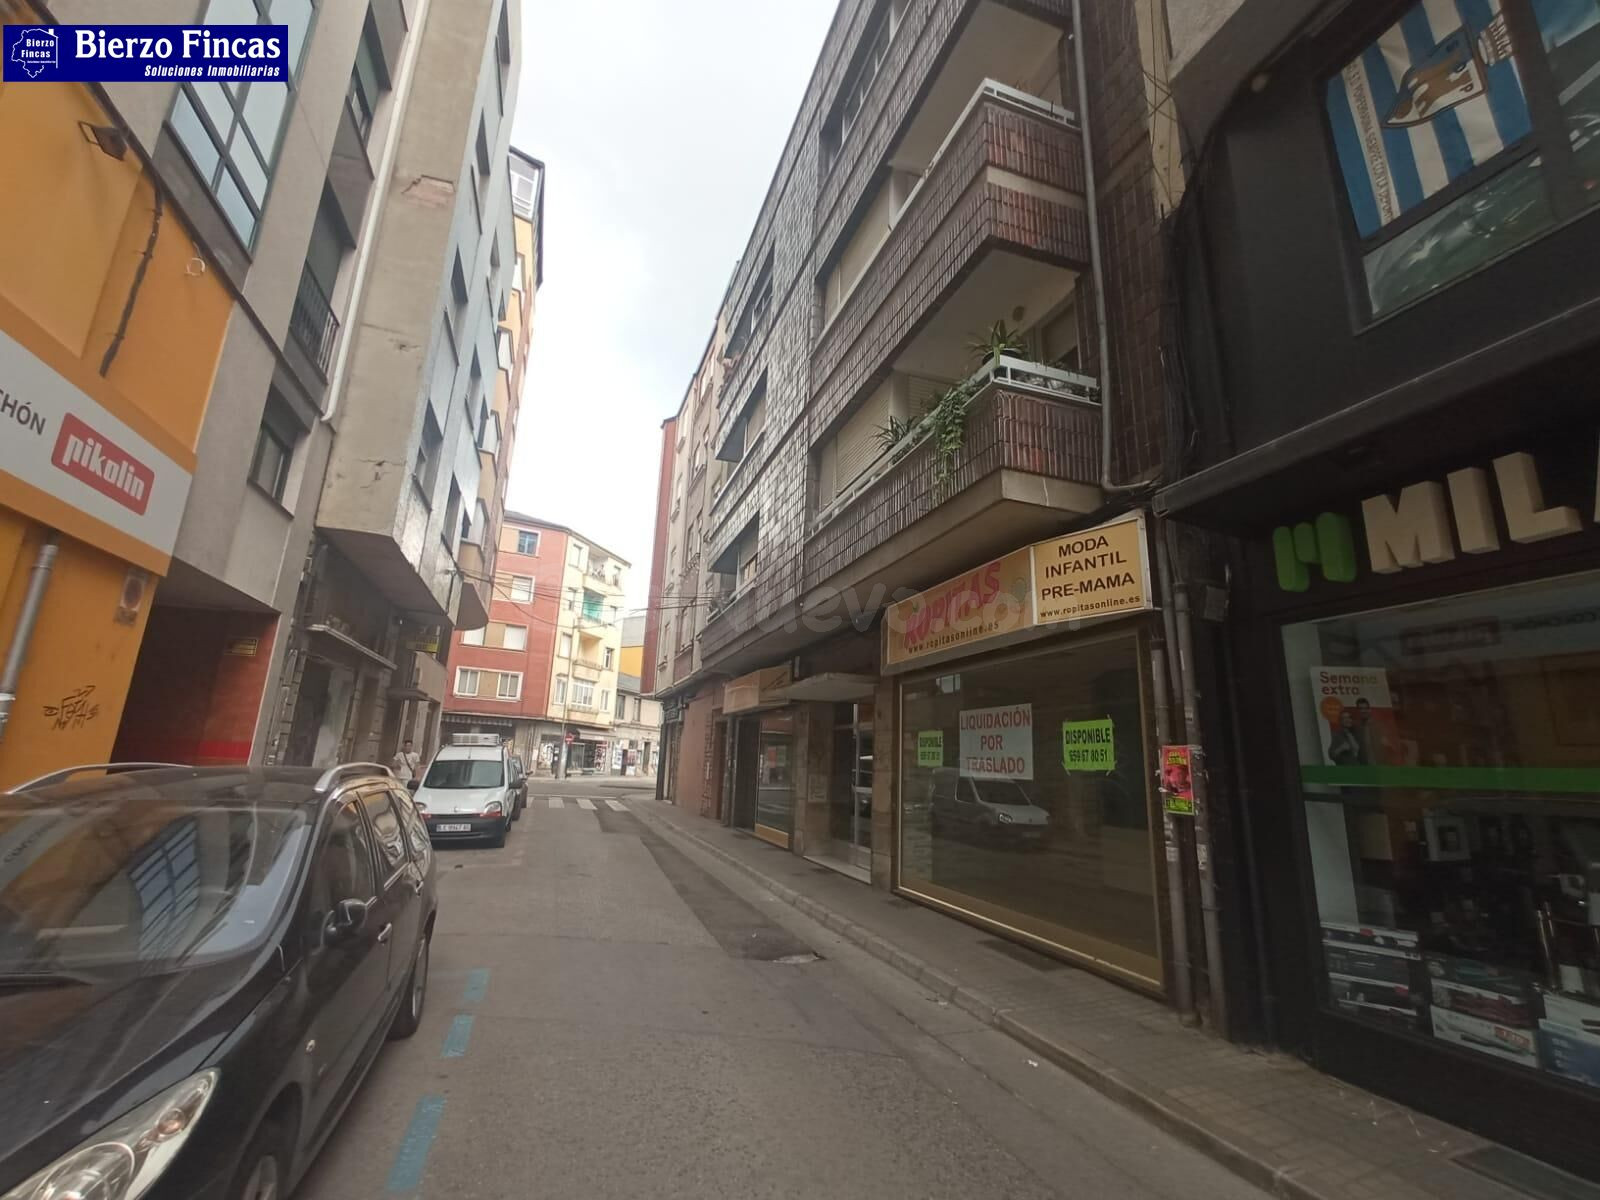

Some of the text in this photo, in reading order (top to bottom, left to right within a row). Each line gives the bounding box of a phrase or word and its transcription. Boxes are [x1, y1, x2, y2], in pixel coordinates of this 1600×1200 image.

[62, 433, 145, 500] pikolin
[1361, 434, 1600, 574] MIL
[1058, 535, 1109, 558] MODA
[1045, 551, 1127, 579] INFANTIL
[1041, 572, 1135, 600] PRE-MAMA
[1040, 595, 1140, 618] www.ropitasonline.es
[1320, 671, 1377, 684] Semana
[1321, 685, 1360, 695] extra
[960, 707, 1031, 730] LIQUIDACIÓN
[980, 735, 1003, 750] POR
[1065, 727, 1110, 744] DISPONIBLE
[967, 756, 1025, 774] TRASLADO
